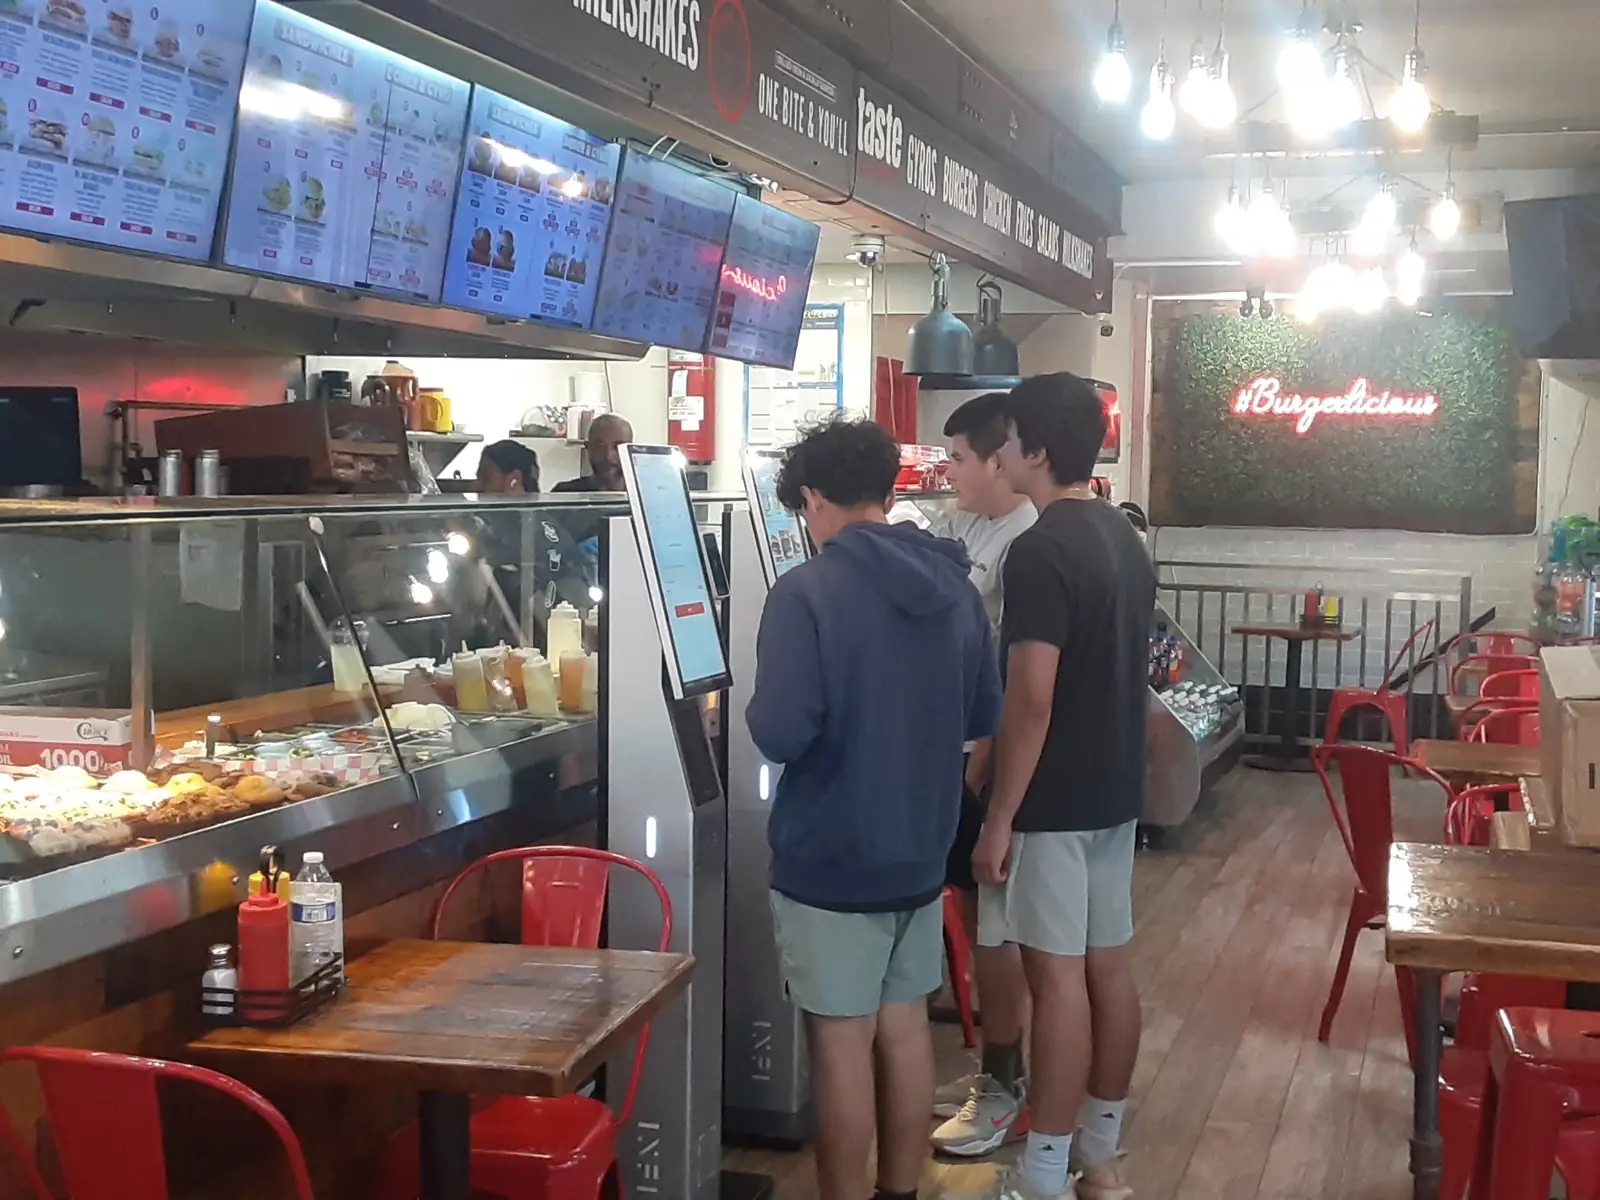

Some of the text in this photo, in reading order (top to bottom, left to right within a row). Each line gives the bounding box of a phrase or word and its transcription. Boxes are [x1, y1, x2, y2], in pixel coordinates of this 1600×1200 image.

[758, 73, 779, 121] ONE
[783, 86, 805, 134] BITE
[807, 101, 814, 139] &
[818, 105, 848, 156] YOU'LL
[857, 87, 903, 168] taste
[906, 134, 938, 197] GYROS
[942, 155, 979, 218] BURGERS
[982, 179, 1013, 237] CHICKEN
[1015, 200, 1034, 248] FRIES
[1037, 214, 1060, 262] SALADS
[1233, 375, 1438, 434] #Burgerlicious
[40, 748, 100, 773] 1000
